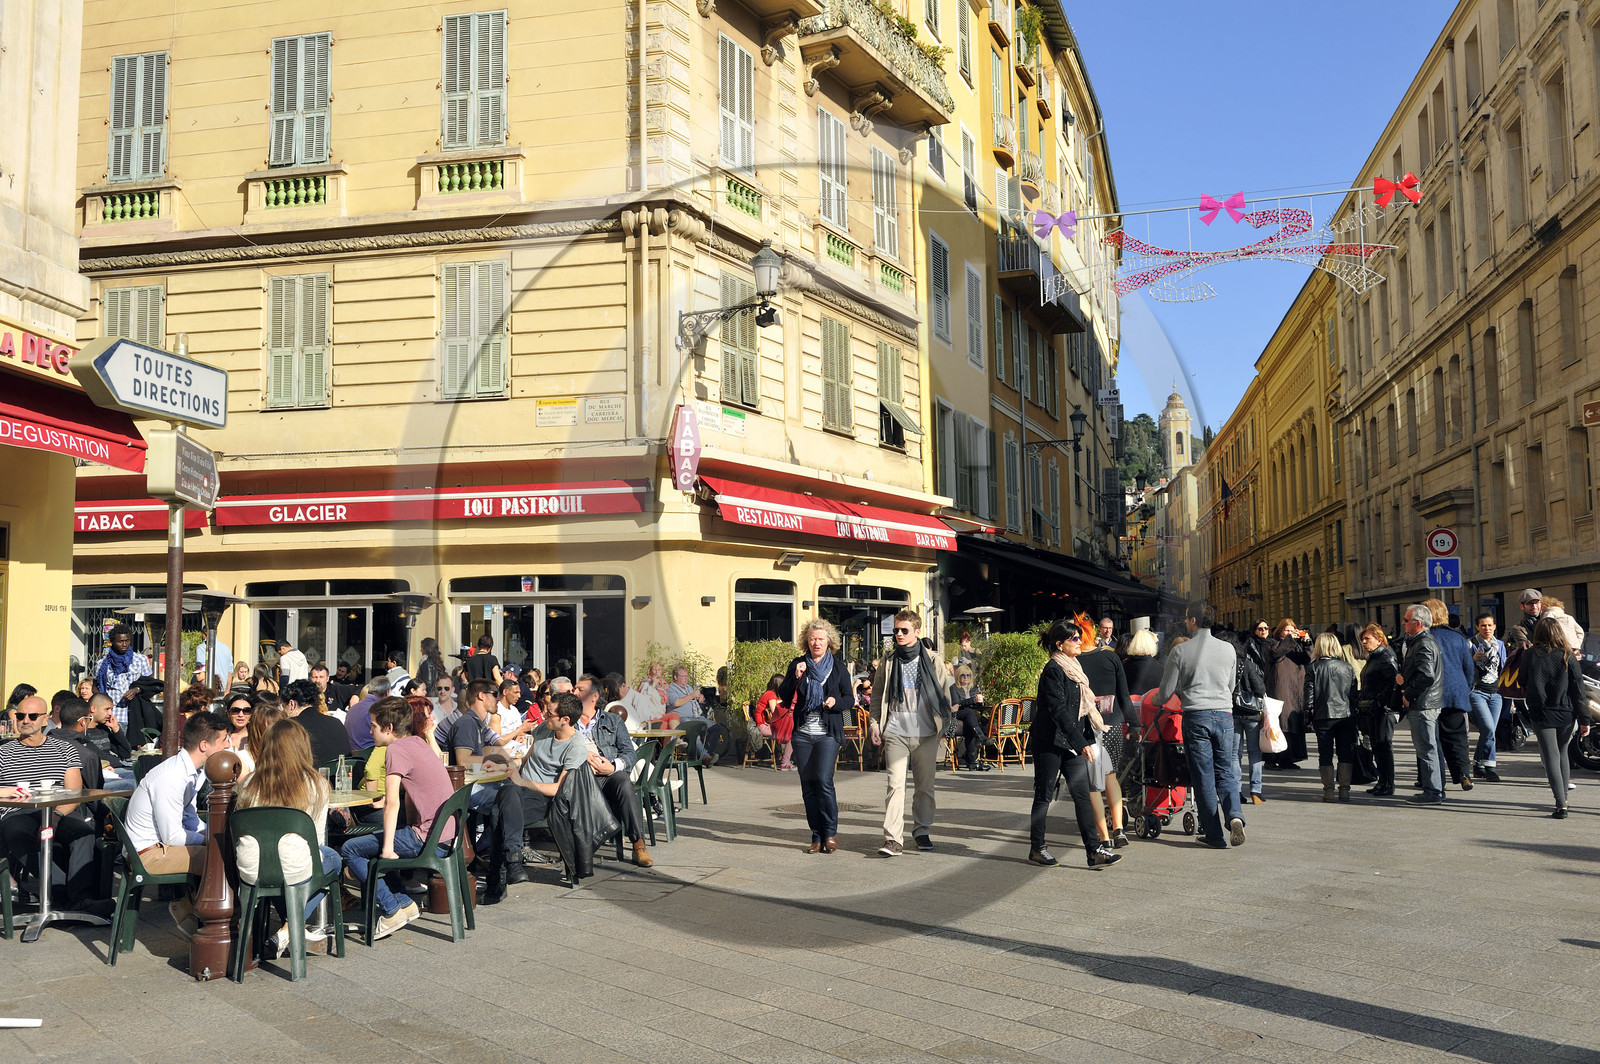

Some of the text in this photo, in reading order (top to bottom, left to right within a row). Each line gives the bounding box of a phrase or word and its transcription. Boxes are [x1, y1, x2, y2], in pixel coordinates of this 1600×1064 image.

[22, 332, 77, 375] DEG
[133, 353, 193, 387] TOUTES
[133, 378, 220, 417] DIRECTIONS
[0, 419, 110, 460] DEGUSTATION
[680, 410, 696, 485] TABAC
[268, 504, 348, 523] GLACIER
[463, 495, 586, 517] LOU PASTROUIL
[77, 513, 136, 531] TABAC
[736, 506, 804, 531] RESTAURANT
[836, 521, 851, 539] LOU
[914, 532, 930, 547] BAR
[935, 536, 950, 549] VIN
[1434, 539, 1446, 547] 19
